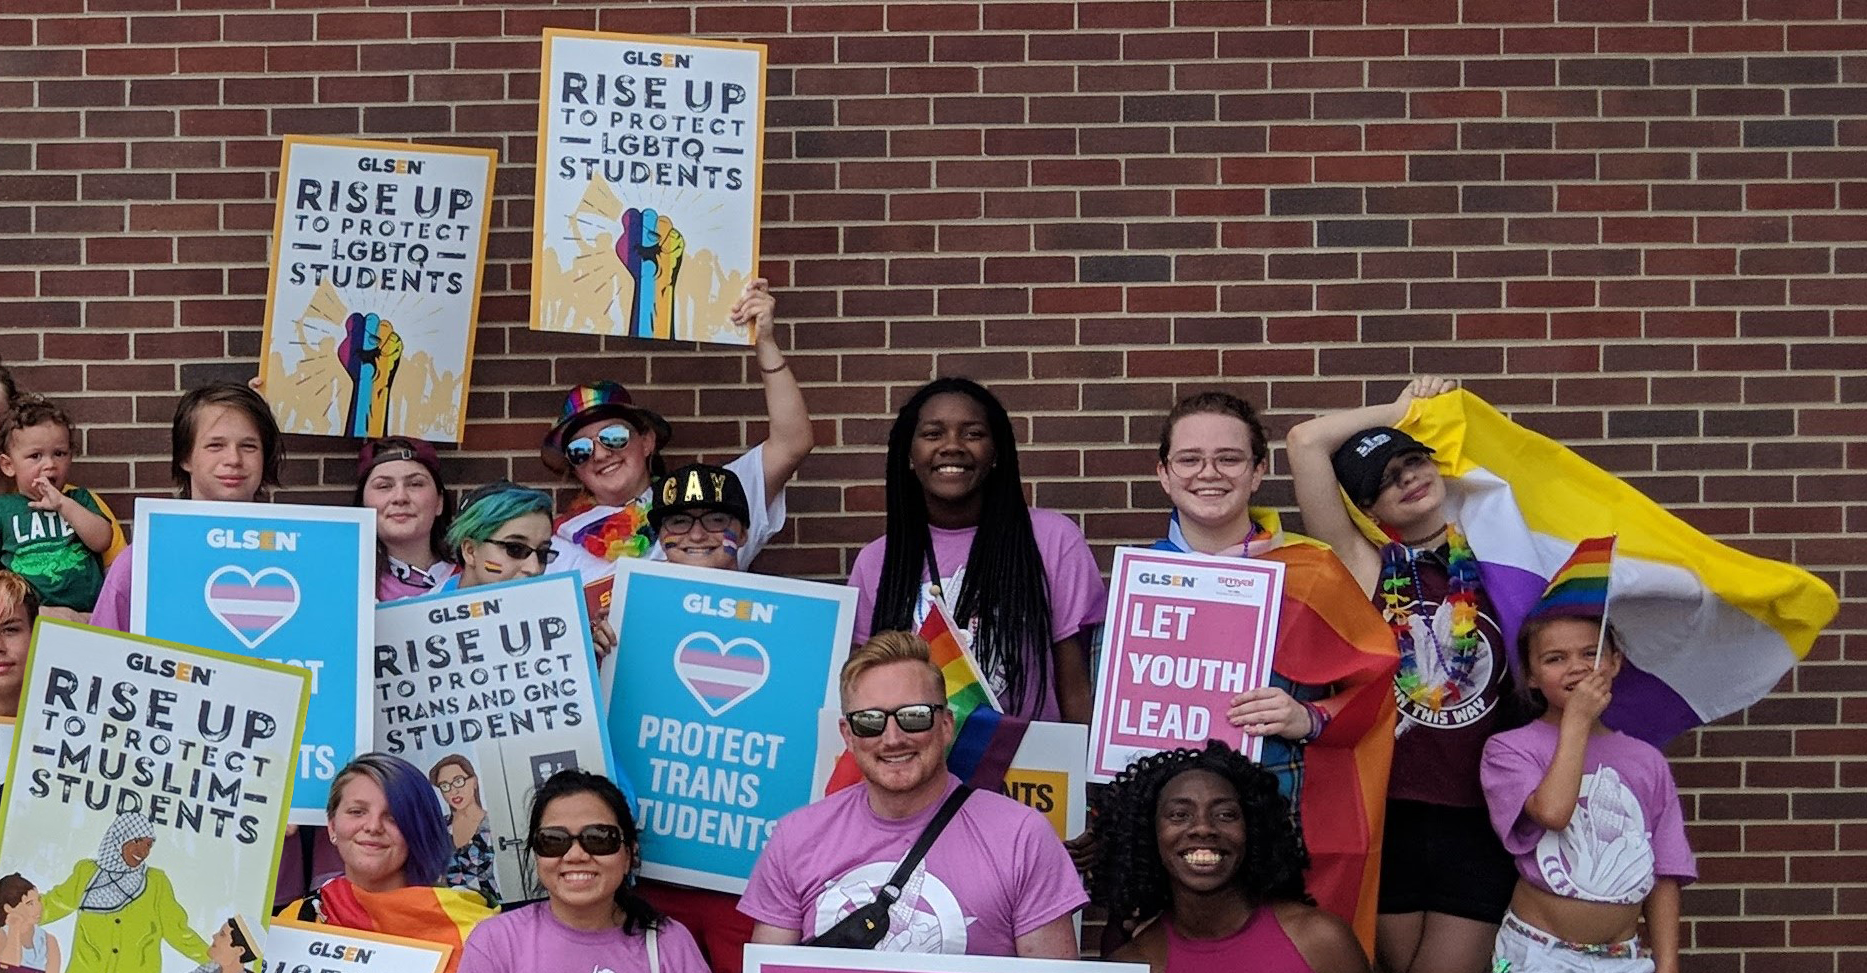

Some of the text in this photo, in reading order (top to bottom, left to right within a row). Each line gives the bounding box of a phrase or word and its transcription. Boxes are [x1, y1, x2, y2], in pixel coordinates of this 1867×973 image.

[623, 50, 690, 68] GLSEN
[562, 72, 746, 114] RISE UP
[561, 109, 745, 136] TO PROTECT
[358, 157, 423, 175] GLSEN
[602, 132, 704, 164] LGBTQ
[559, 157, 742, 191] STUDENTS
[296, 179, 473, 219] RISE UP
[295, 215, 470, 241] TO PROTECT
[332, 239, 429, 268] LGBTQ
[289, 263, 463, 294] STUDENTS
[663, 471, 726, 506] GAY
[206, 528, 297, 551] GLSEN
[1138, 573, 1195, 588] GLSEN
[429, 600, 500, 624] GLSEN
[683, 593, 775, 624] GLSEN
[1130, 602, 1196, 641] LET
[375, 630, 484, 678] RISE
[499, 617, 567, 657] UP
[127, 653, 212, 686] GLSEN
[377, 654, 572, 701] TO PROTECT
[1128, 652, 1247, 693] YOUTH
[45, 667, 277, 749] RISE UP
[382, 678, 578, 725] TRANS AND GNC
[1452, 696, 1486, 723] WAY
[386, 702, 582, 755] STUDENTS
[1118, 699, 1211, 742] LEAD
[42, 708, 86, 737] TO
[101, 723, 270, 777] PROTECT
[638, 715, 786, 769] PROTECT
[57, 739, 243, 808] MUSLIM
[650, 758, 760, 809] TRANS
[29, 768, 260, 845] STUDENTS
[637, 800, 778, 851] TUDENTS
[309, 941, 373, 965] GLSEN
